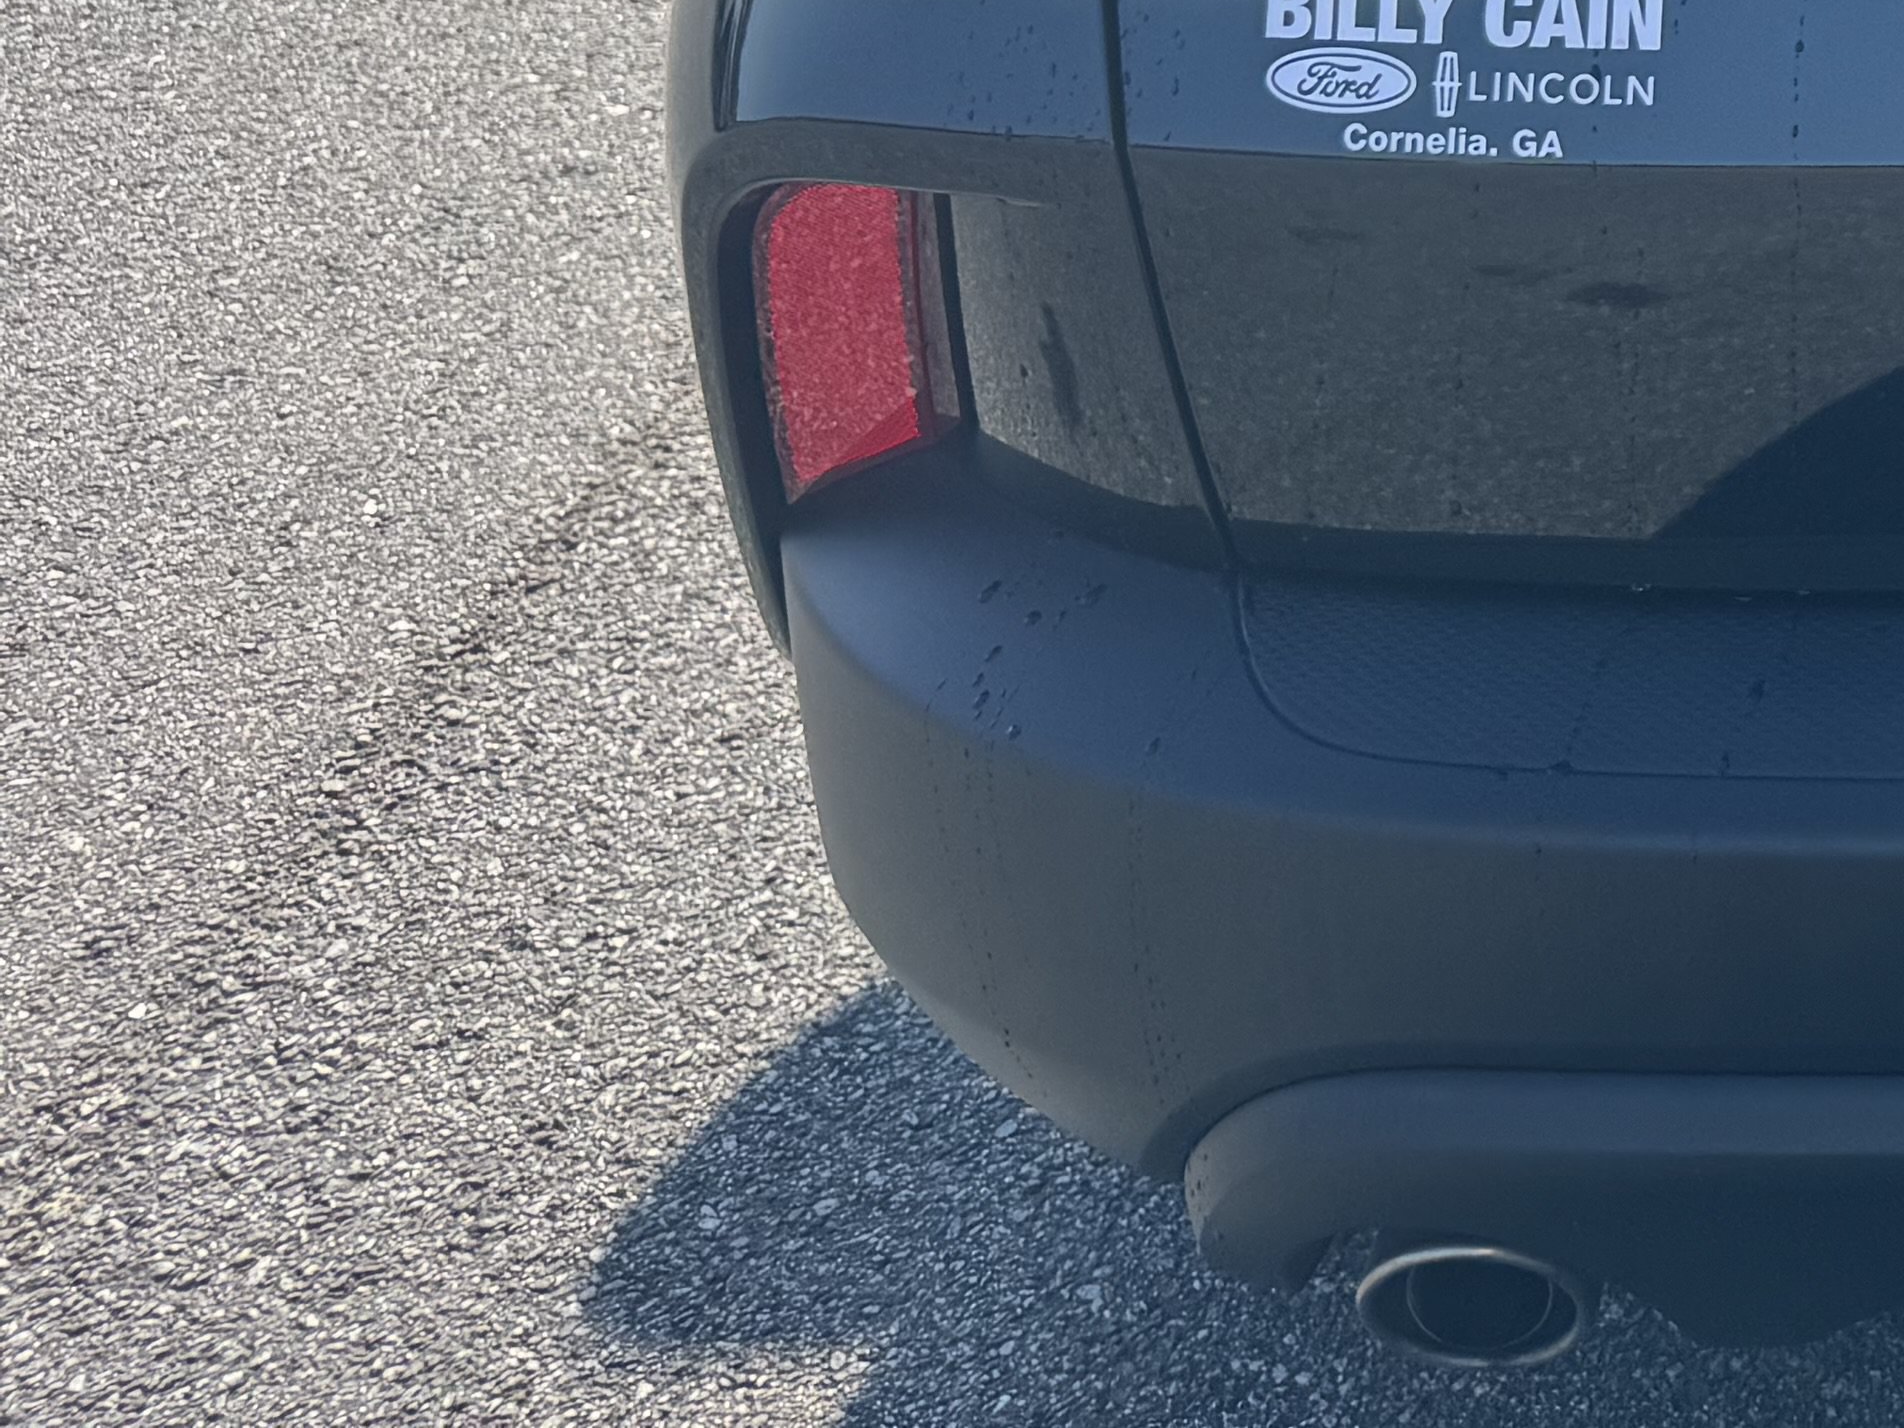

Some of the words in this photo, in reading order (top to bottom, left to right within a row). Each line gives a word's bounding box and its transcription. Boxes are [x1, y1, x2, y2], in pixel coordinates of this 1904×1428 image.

[1296, 60, 1383, 102] Ford
[1468, 71, 1656, 107] LINCOLN
[1511, 128, 1564, 158] GA
